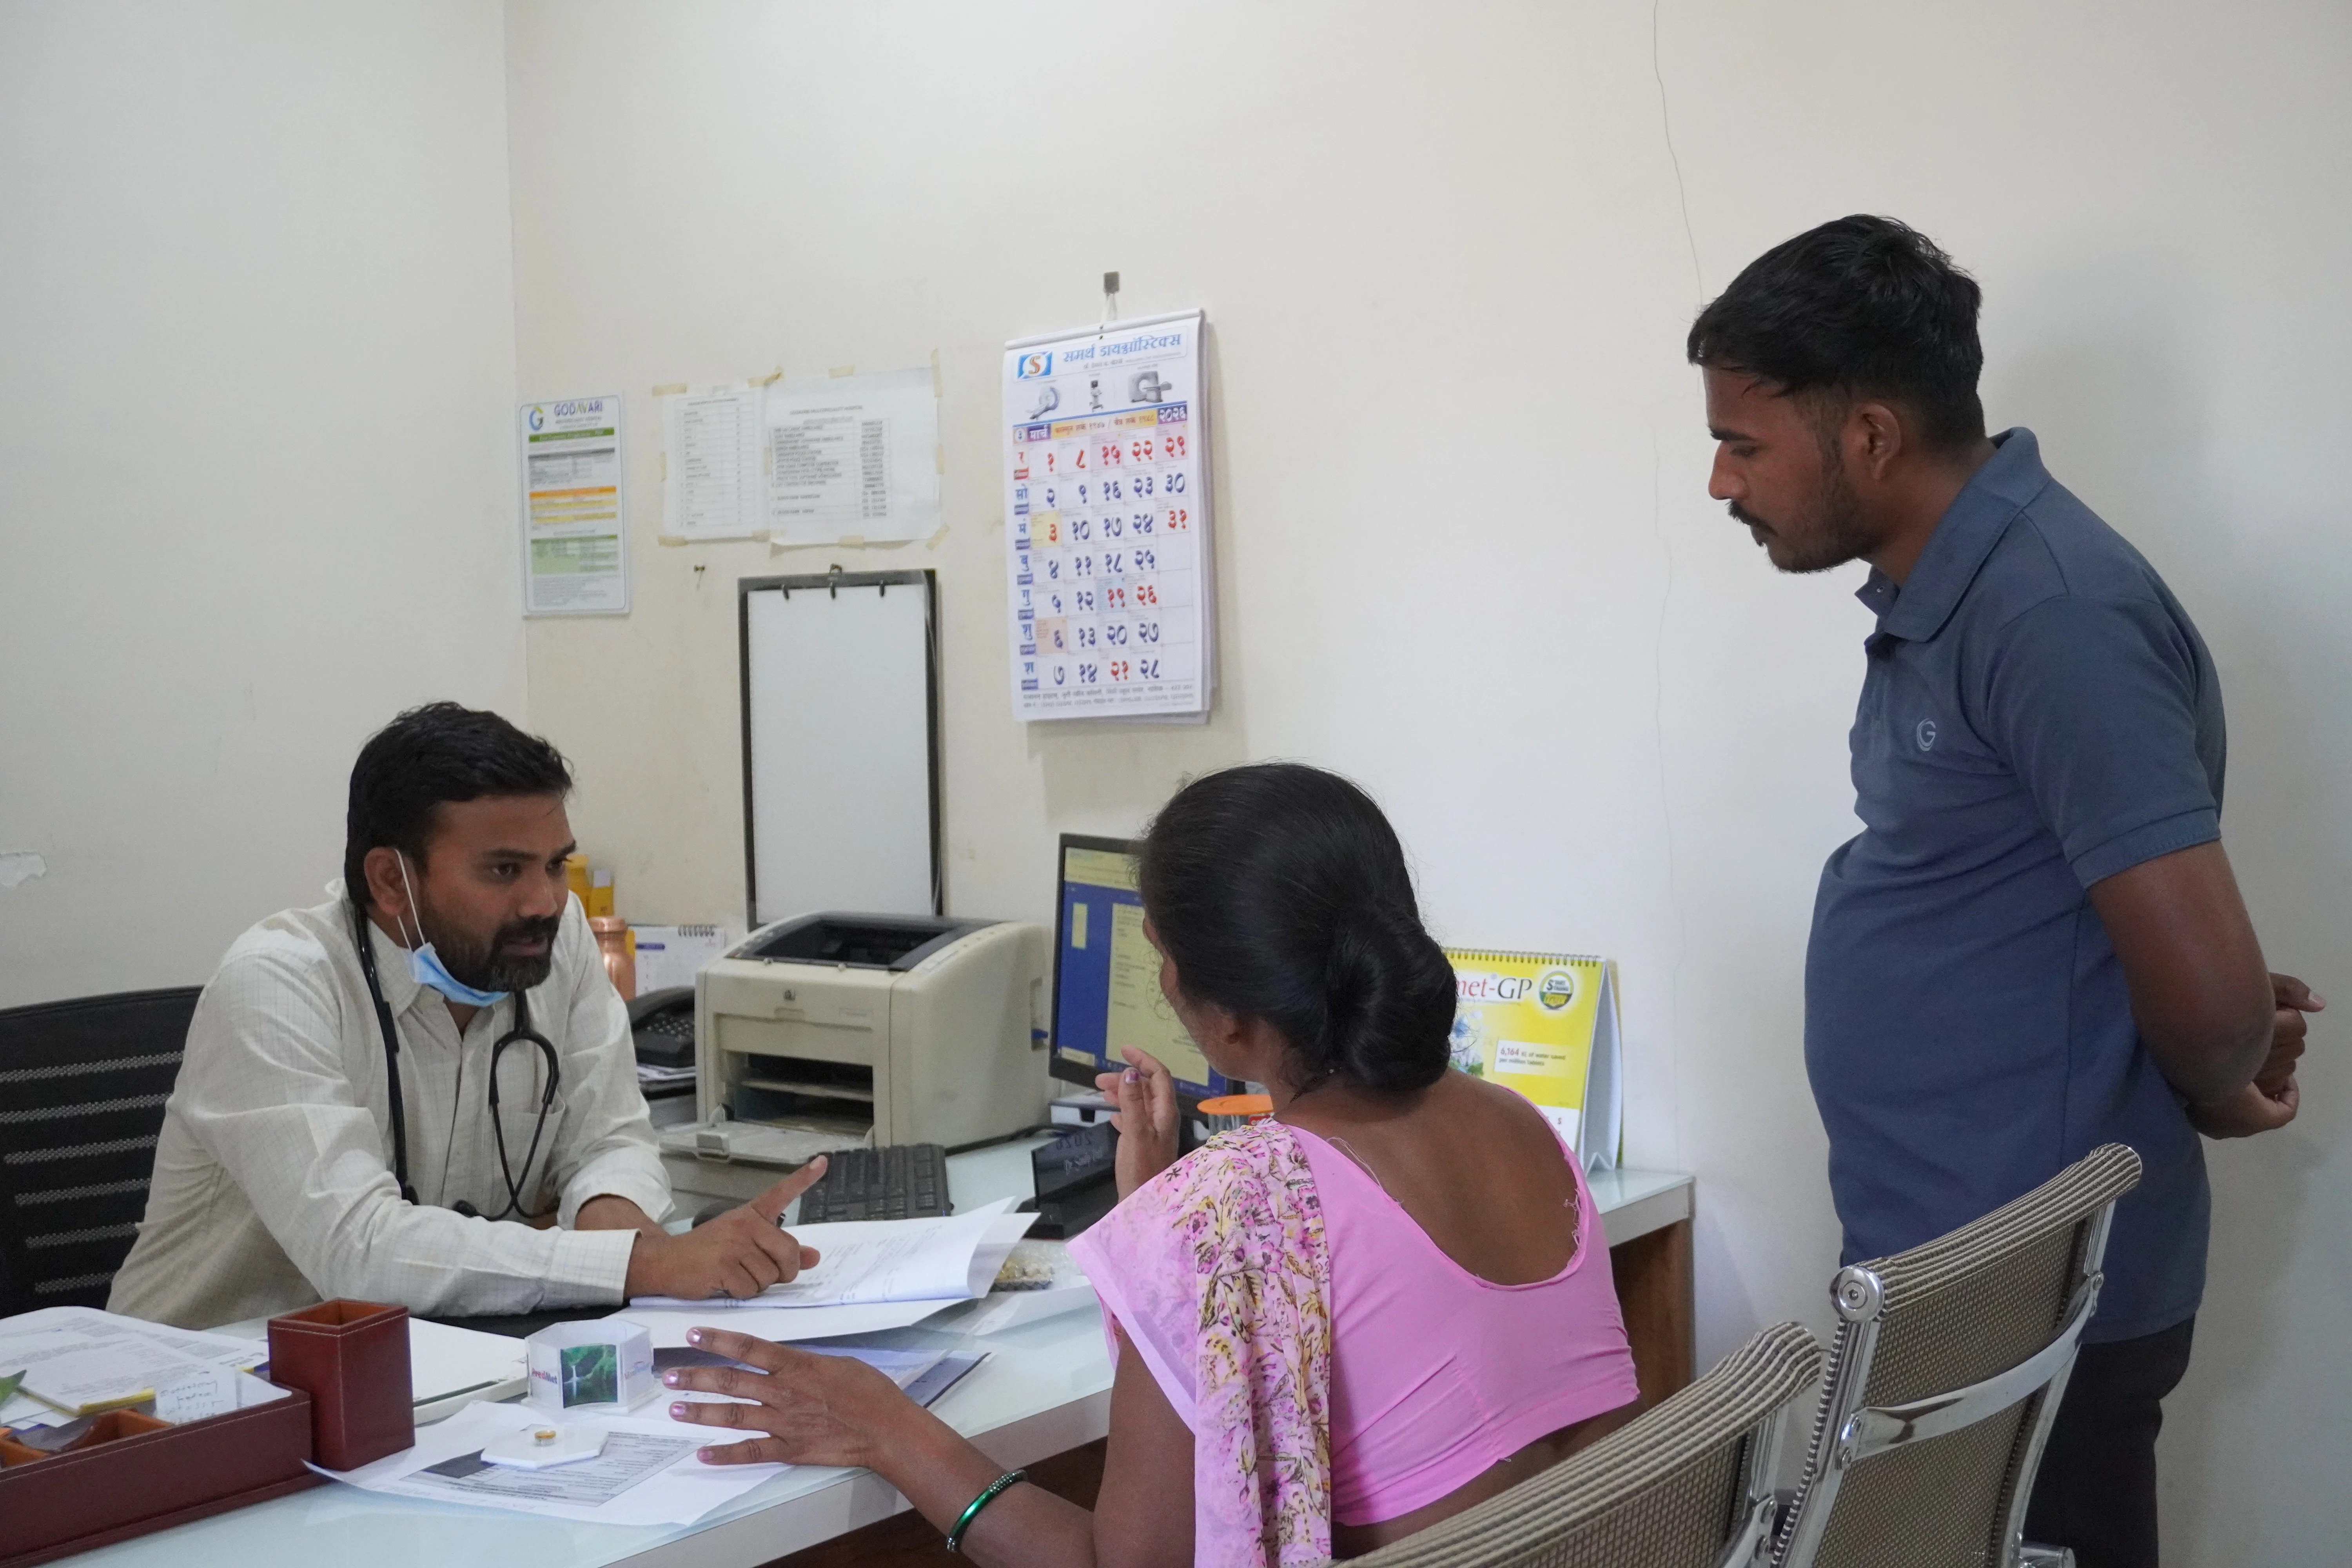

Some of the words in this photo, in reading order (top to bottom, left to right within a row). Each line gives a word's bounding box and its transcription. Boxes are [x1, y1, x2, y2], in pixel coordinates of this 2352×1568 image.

[1063, 343, 1096, 363] समर्थ
[1048, 452, 1054, 472] १
[1076, 449, 1086, 469] ८
[1102, 445, 1121, 466] १५
[1132, 441, 1153, 462] २२
[1165, 436, 1186, 458] २९
[1047, 488, 1055, 508] २
[1079, 485, 1087, 505] ९
[1103, 481, 1122, 502] १६
[1134, 477, 1154, 499] २३
[1165, 473, 1185, 494] ३०
[1049, 523, 1058, 543] ३
[1072, 521, 1091, 541] १०
[1104, 517, 1122, 538] १७
[1133, 514, 1154, 534] २४
[1168, 509, 1188, 530] ३१
[1048, 559, 1059, 580] ४
[1075, 556, 1093, 577] ११
[1105, 554, 1123, 574] १८
[1135, 550, 1156, 571] २५
[1051, 594, 1062, 614] ५
[1076, 591, 1094, 612] १२
[1107, 588, 1126, 609] १९
[1137, 585, 1158, 606] २६
[1054, 630, 1064, 649] ६
[1078, 627, 1097, 648] १३
[1107, 625, 1128, 646] २०
[1139, 622, 1160, 643] २७
[1053, 665, 1065, 686] ७
[1079, 663, 1098, 684] १४
[1111, 661, 1129, 682] २१
[1140, 659, 1160, 680] २८
